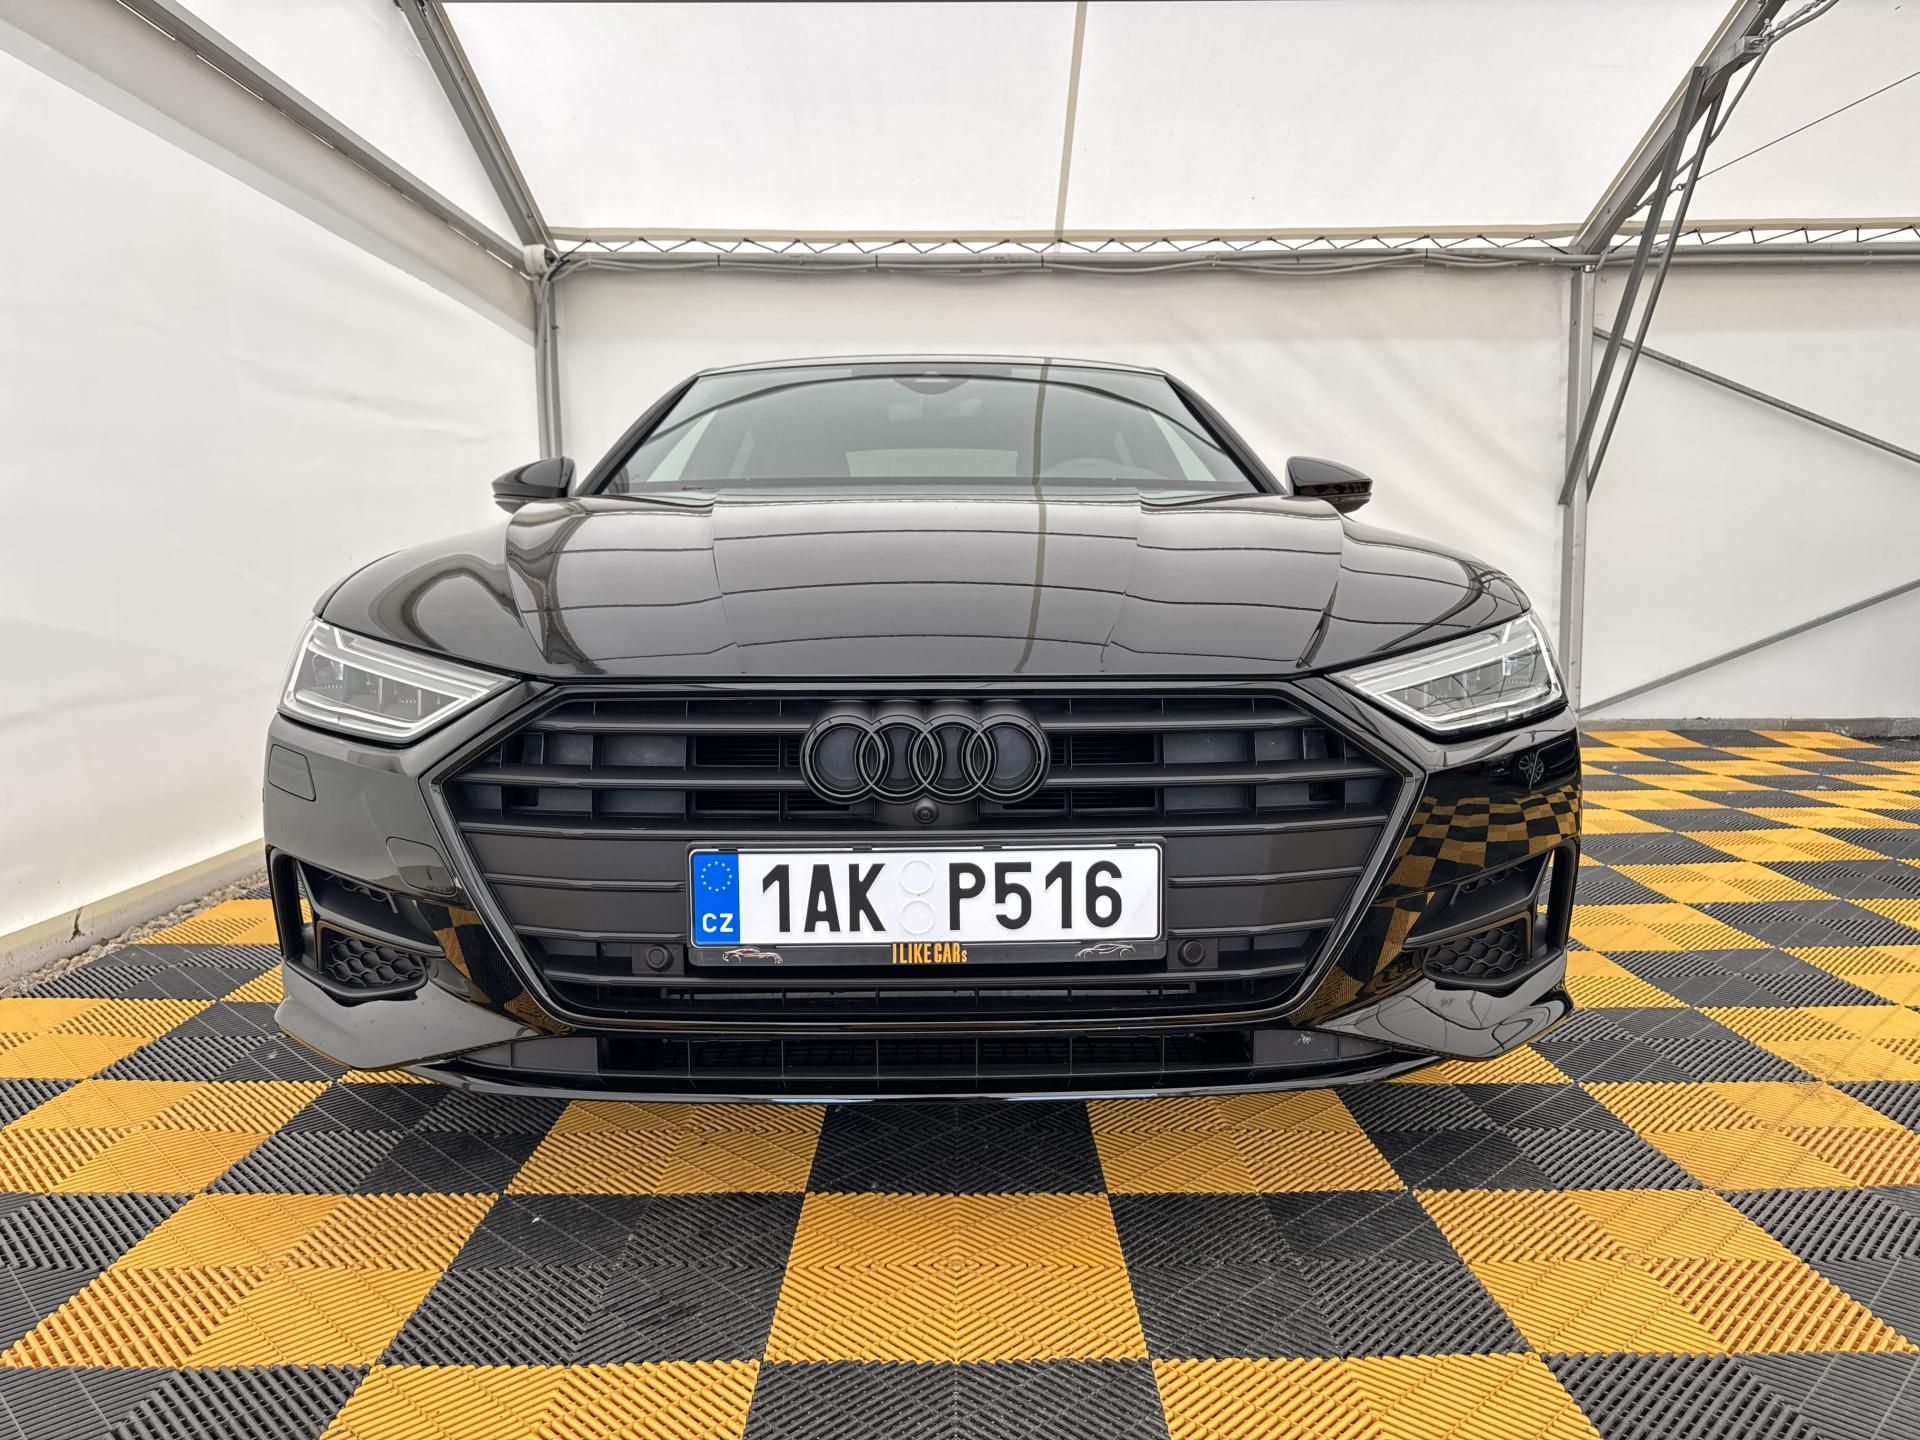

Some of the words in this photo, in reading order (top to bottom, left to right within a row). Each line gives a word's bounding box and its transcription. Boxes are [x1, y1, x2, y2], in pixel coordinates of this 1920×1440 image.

[763, 864, 885, 932] 1AK
[950, 861, 1121, 930] P516
[703, 913, 733, 932] CZ
[892, 943, 897, 964] I
[899, 943, 932, 964] LIKE
